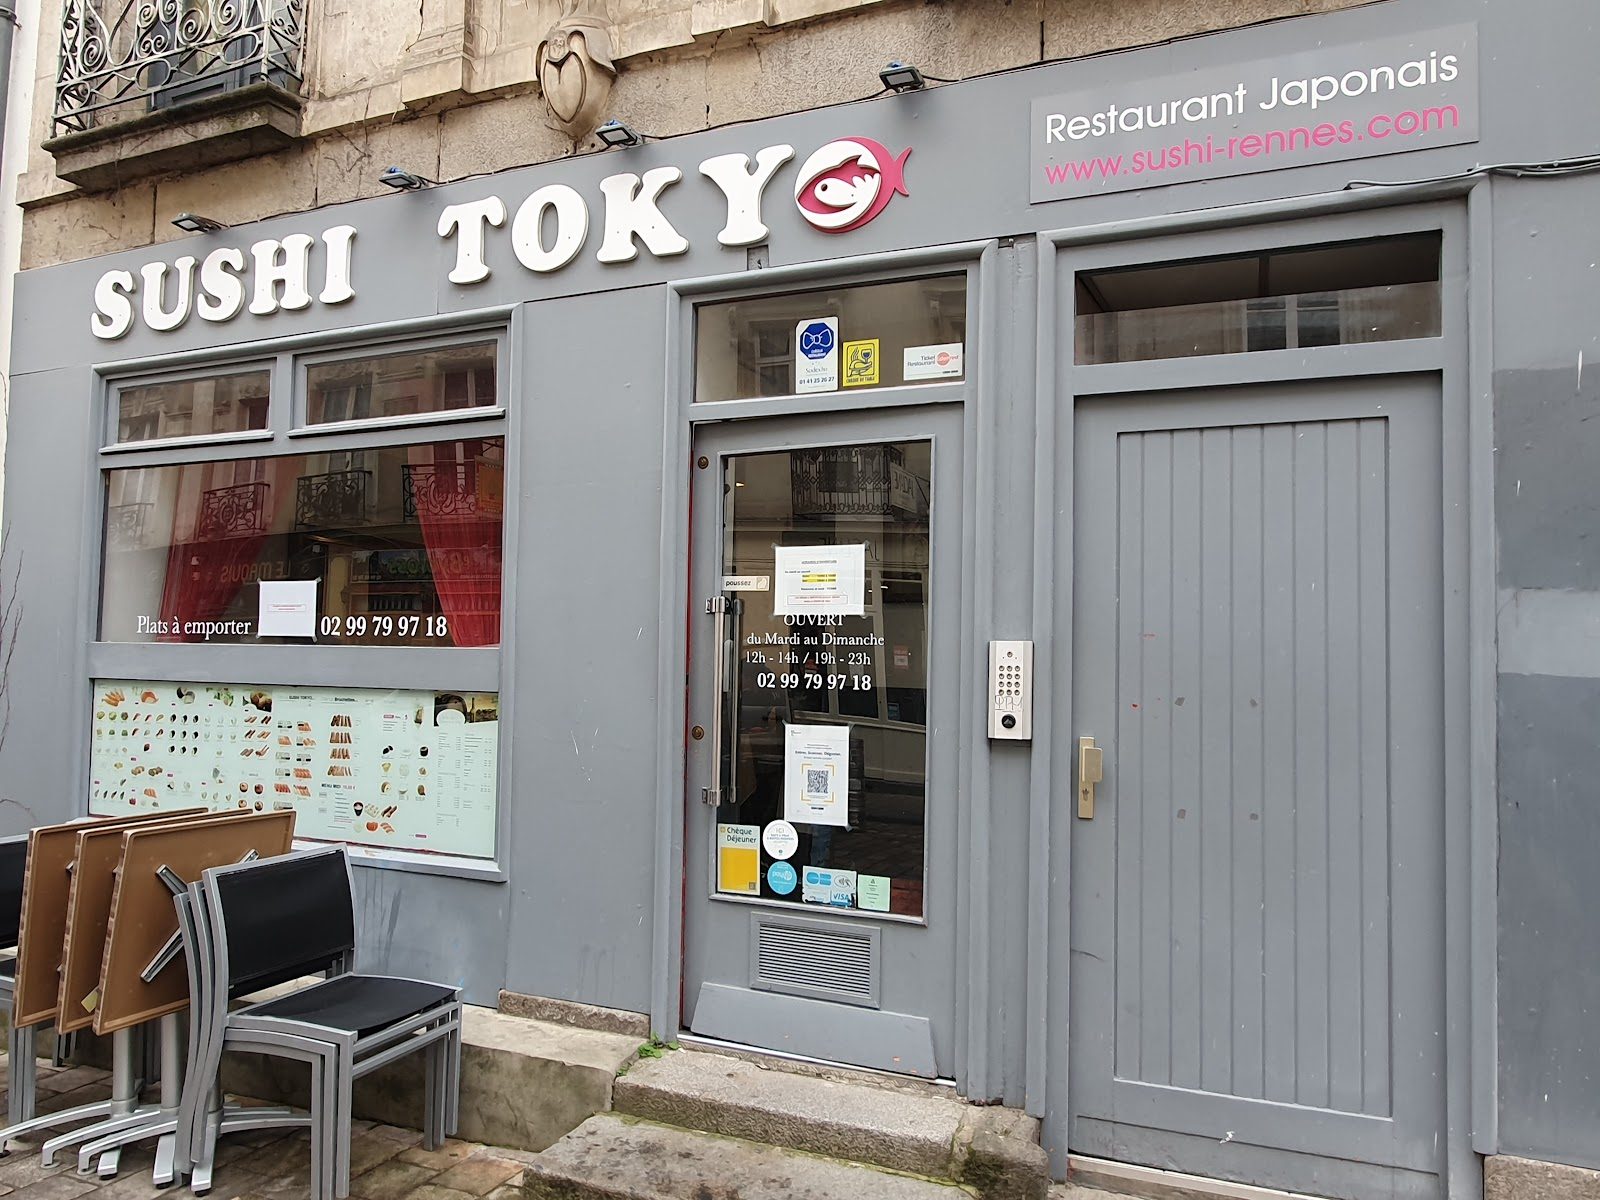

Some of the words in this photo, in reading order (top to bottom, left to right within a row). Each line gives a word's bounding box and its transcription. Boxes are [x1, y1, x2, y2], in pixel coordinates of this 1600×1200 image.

[1045, 83, 1247, 144] Restaurant
[1259, 50, 1458, 109] Japonais
[1044, 104, 1459, 185] www.sushi-rennes.com
[91, 225, 358, 339] SUSHI
[725, 579, 751, 587] poussez
[320, 616, 341, 636] 02
[346, 616, 367, 636] 99
[371, 616, 393, 636] 79
[397, 616, 420, 637] 97
[425, 616, 447, 637] 18
[783, 614, 846, 626] OUVERT
[136, 615, 168, 634] Plats
[172, 616, 181, 634] à
[184, 619, 251, 640] emporter
[747, 632, 761, 645] du
[764, 632, 800, 645] Mardi
[803, 636, 818, 645] au
[822, 633, 885, 646] Dimanche
[746, 652, 766, 664] 12h
[779, 652, 799, 664] 14h
[815, 652, 836, 665] 19h
[848, 653, 871, 665] 23h
[757, 673, 776, 688] 02
[780, 673, 799, 688] 99
[803, 674, 823, 689] 79
[827, 675, 847, 690] 97
[852, 675, 872, 690] 18
[727, 826, 752, 835] Chèque
[727, 835, 757, 843] Déjeuner
[833, 892, 849, 900] VISA
